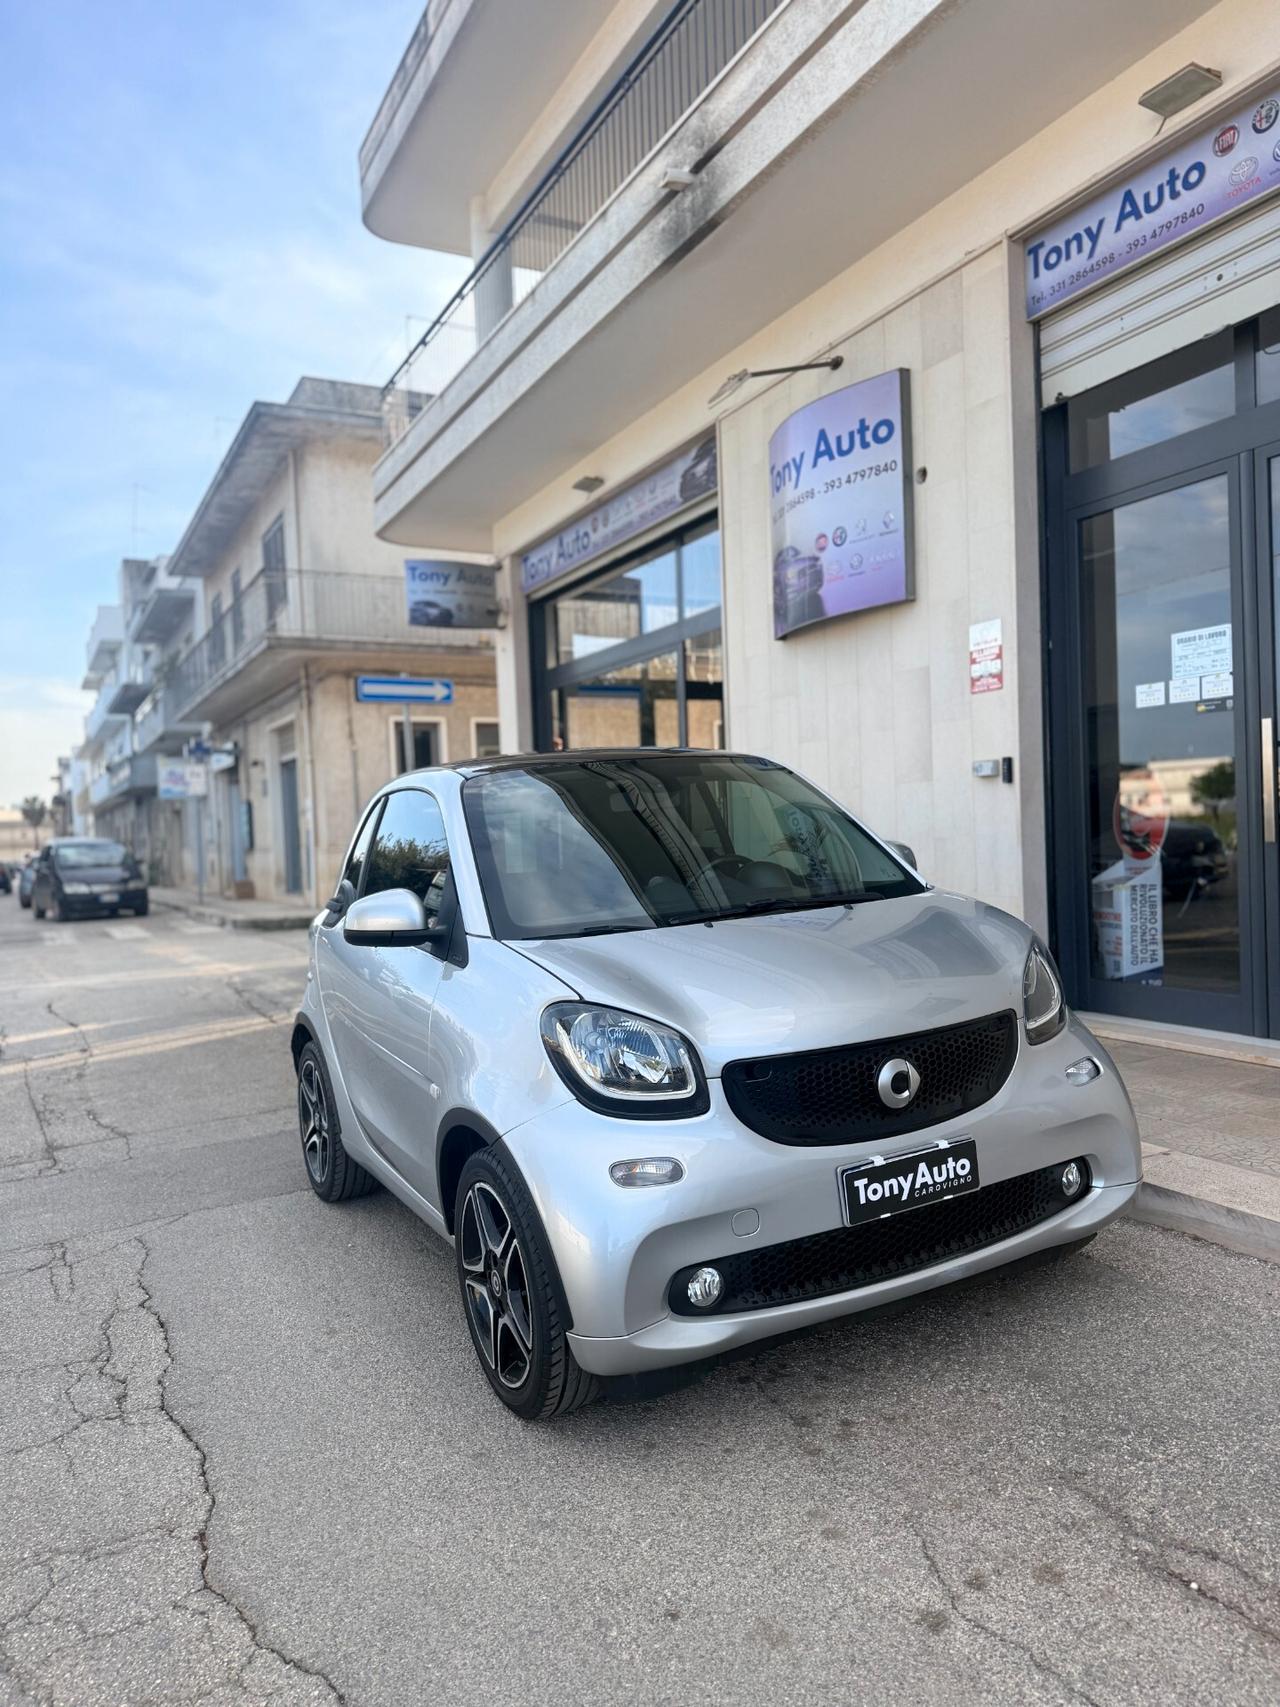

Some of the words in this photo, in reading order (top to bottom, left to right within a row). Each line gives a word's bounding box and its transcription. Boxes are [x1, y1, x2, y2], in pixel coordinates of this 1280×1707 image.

[1227, 177, 1262, 199] TOYOTA
[1026, 217, 1106, 280] Tony
[1113, 160, 1207, 235] Auto
[1031, 293, 1047, 307] Tel.
[1050, 280, 1067, 297] 331
[1068, 252, 1116, 287] 2864598
[1126, 234, 1148, 254] 393
[1149, 203, 1206, 241] 4797840
[811, 417, 896, 469] Auto
[823, 477, 843, 494] 393
[845, 459, 898, 486] 4797840
[522, 553, 553, 582] Tony
[556, 527, 591, 566] Auto
[408, 565, 451, 586] Tony
[456, 567, 494, 587] Auto
[1140, 884, 1148, 955] RIVOLUZIONATO
[1148, 895, 1157, 925] LIBRO
[1148, 927, 1158, 946] CHE
[1149, 949, 1158, 964] HA
[914, 1175, 972, 1198] CAROVIGNO
